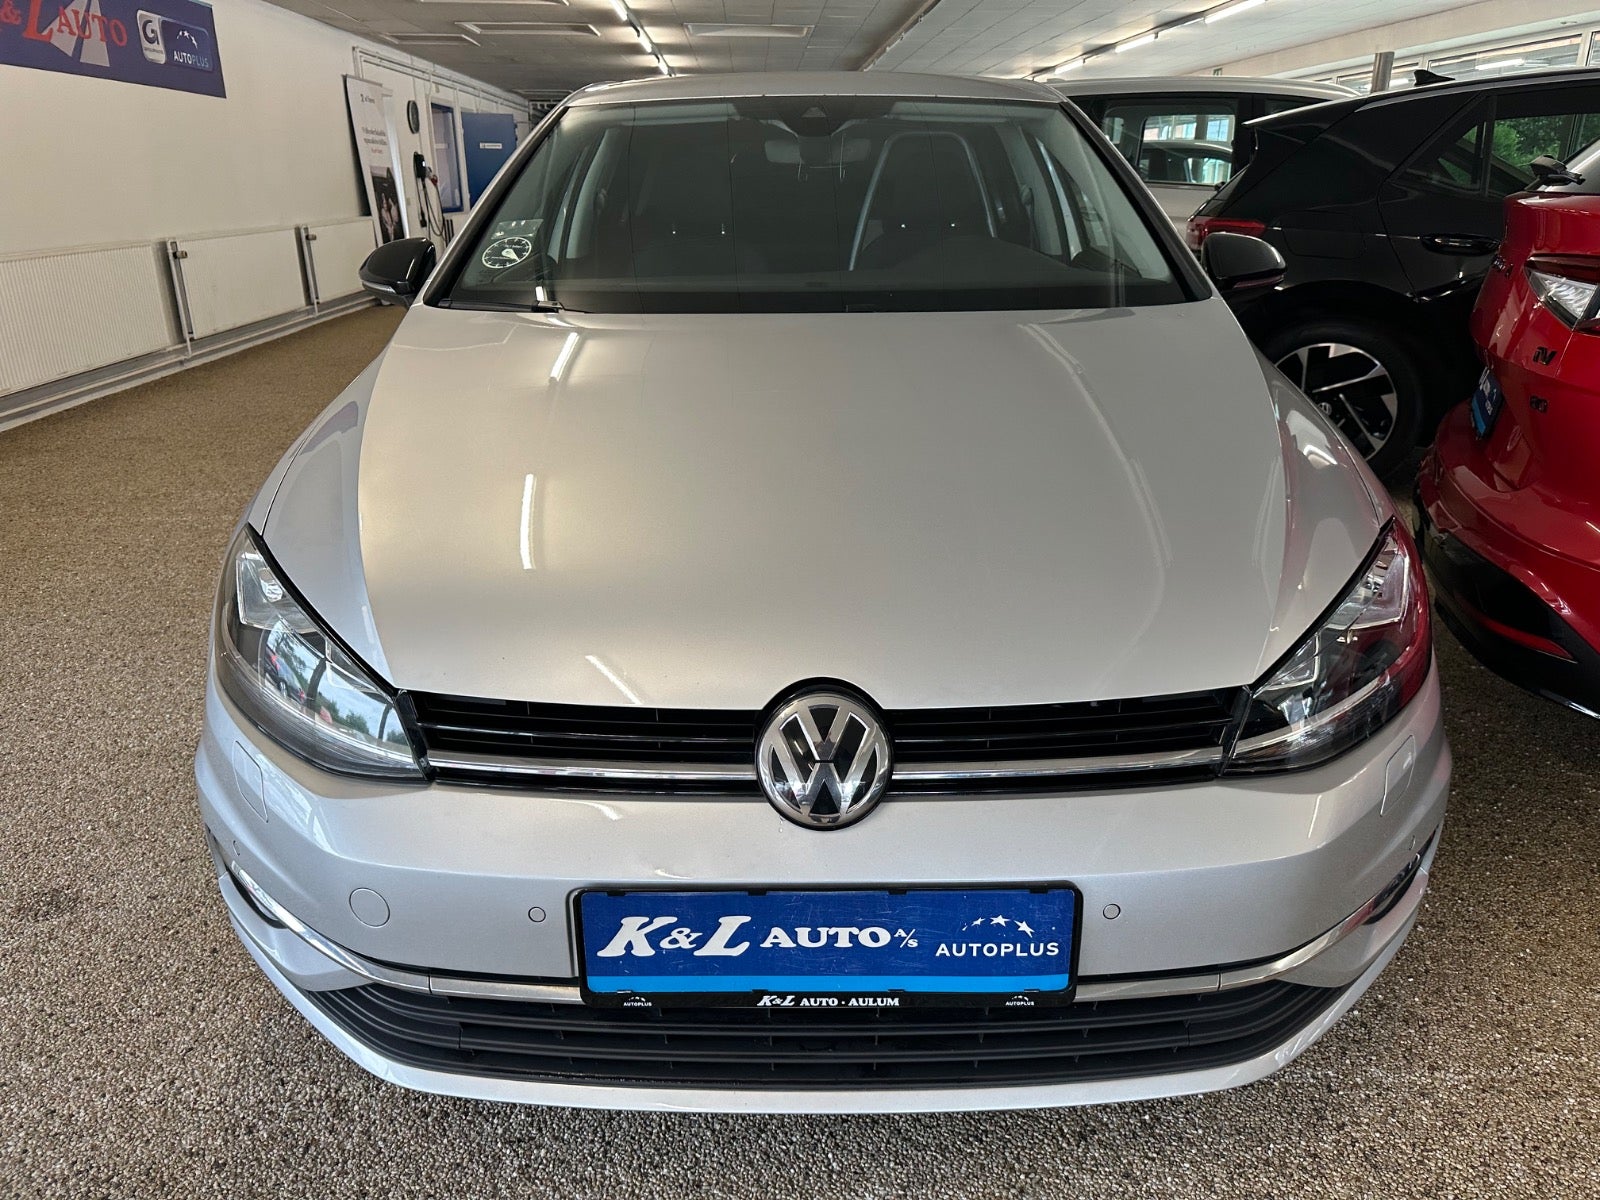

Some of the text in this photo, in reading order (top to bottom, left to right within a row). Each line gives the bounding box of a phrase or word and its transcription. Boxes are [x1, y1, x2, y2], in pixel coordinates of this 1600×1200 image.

[57, 6, 128, 47] AUTO
[173, 50, 209, 68] AUTOPLUS
[597, 916, 752, 957] K&L
[759, 926, 891, 948] AUTO
[935, 943, 1060, 957] AUTOPLUS
[757, 995, 900, 1007] K&L AUTO AULUM
